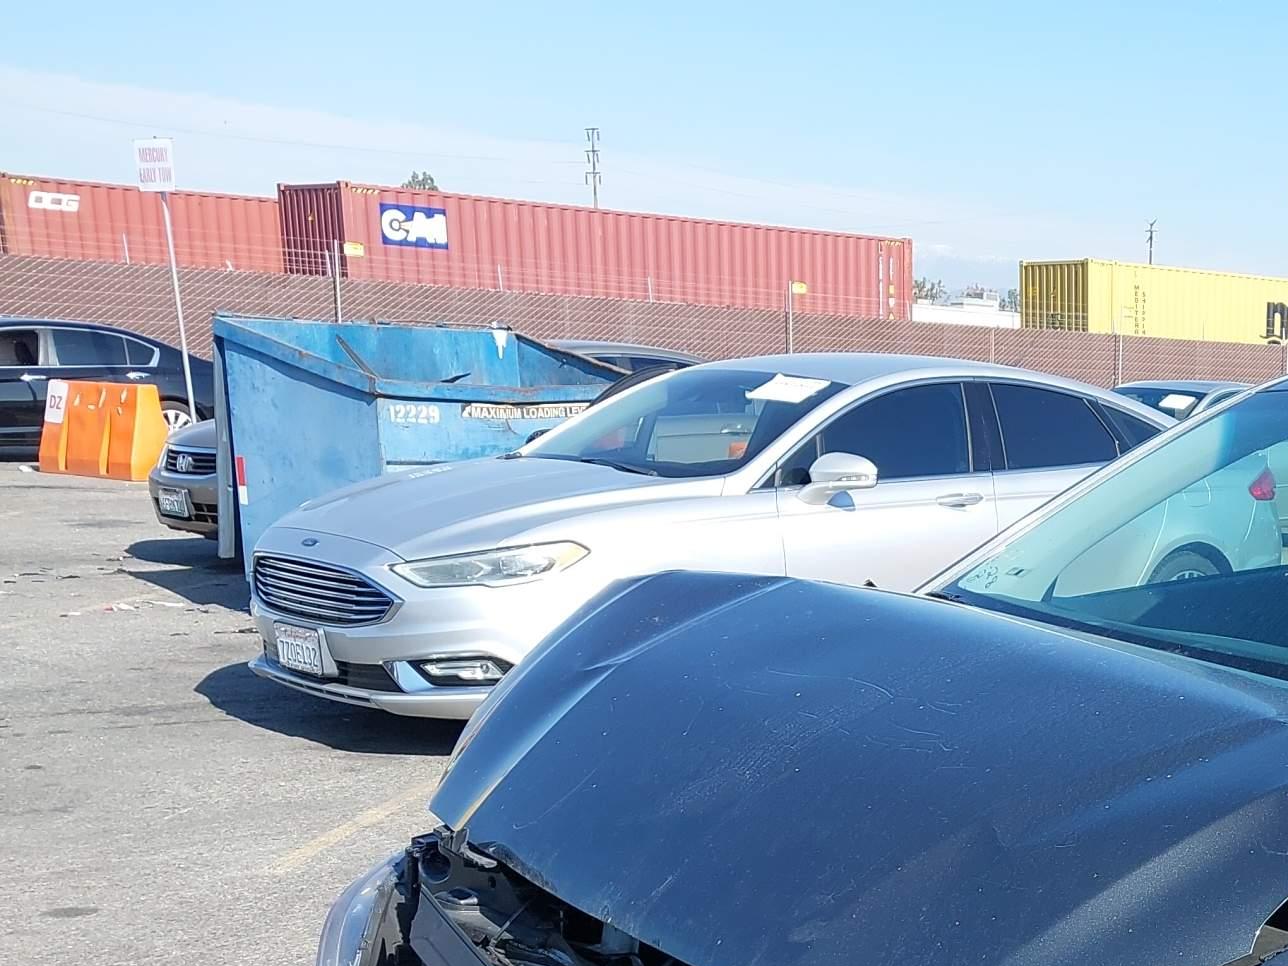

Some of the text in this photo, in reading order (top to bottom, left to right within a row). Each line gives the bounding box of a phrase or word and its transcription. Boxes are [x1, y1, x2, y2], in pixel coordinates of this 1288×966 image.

[388, 404, 440, 424] 12229
[471, 405, 523, 420] MAXIMUM
[523, 406, 566, 419] LOADING
